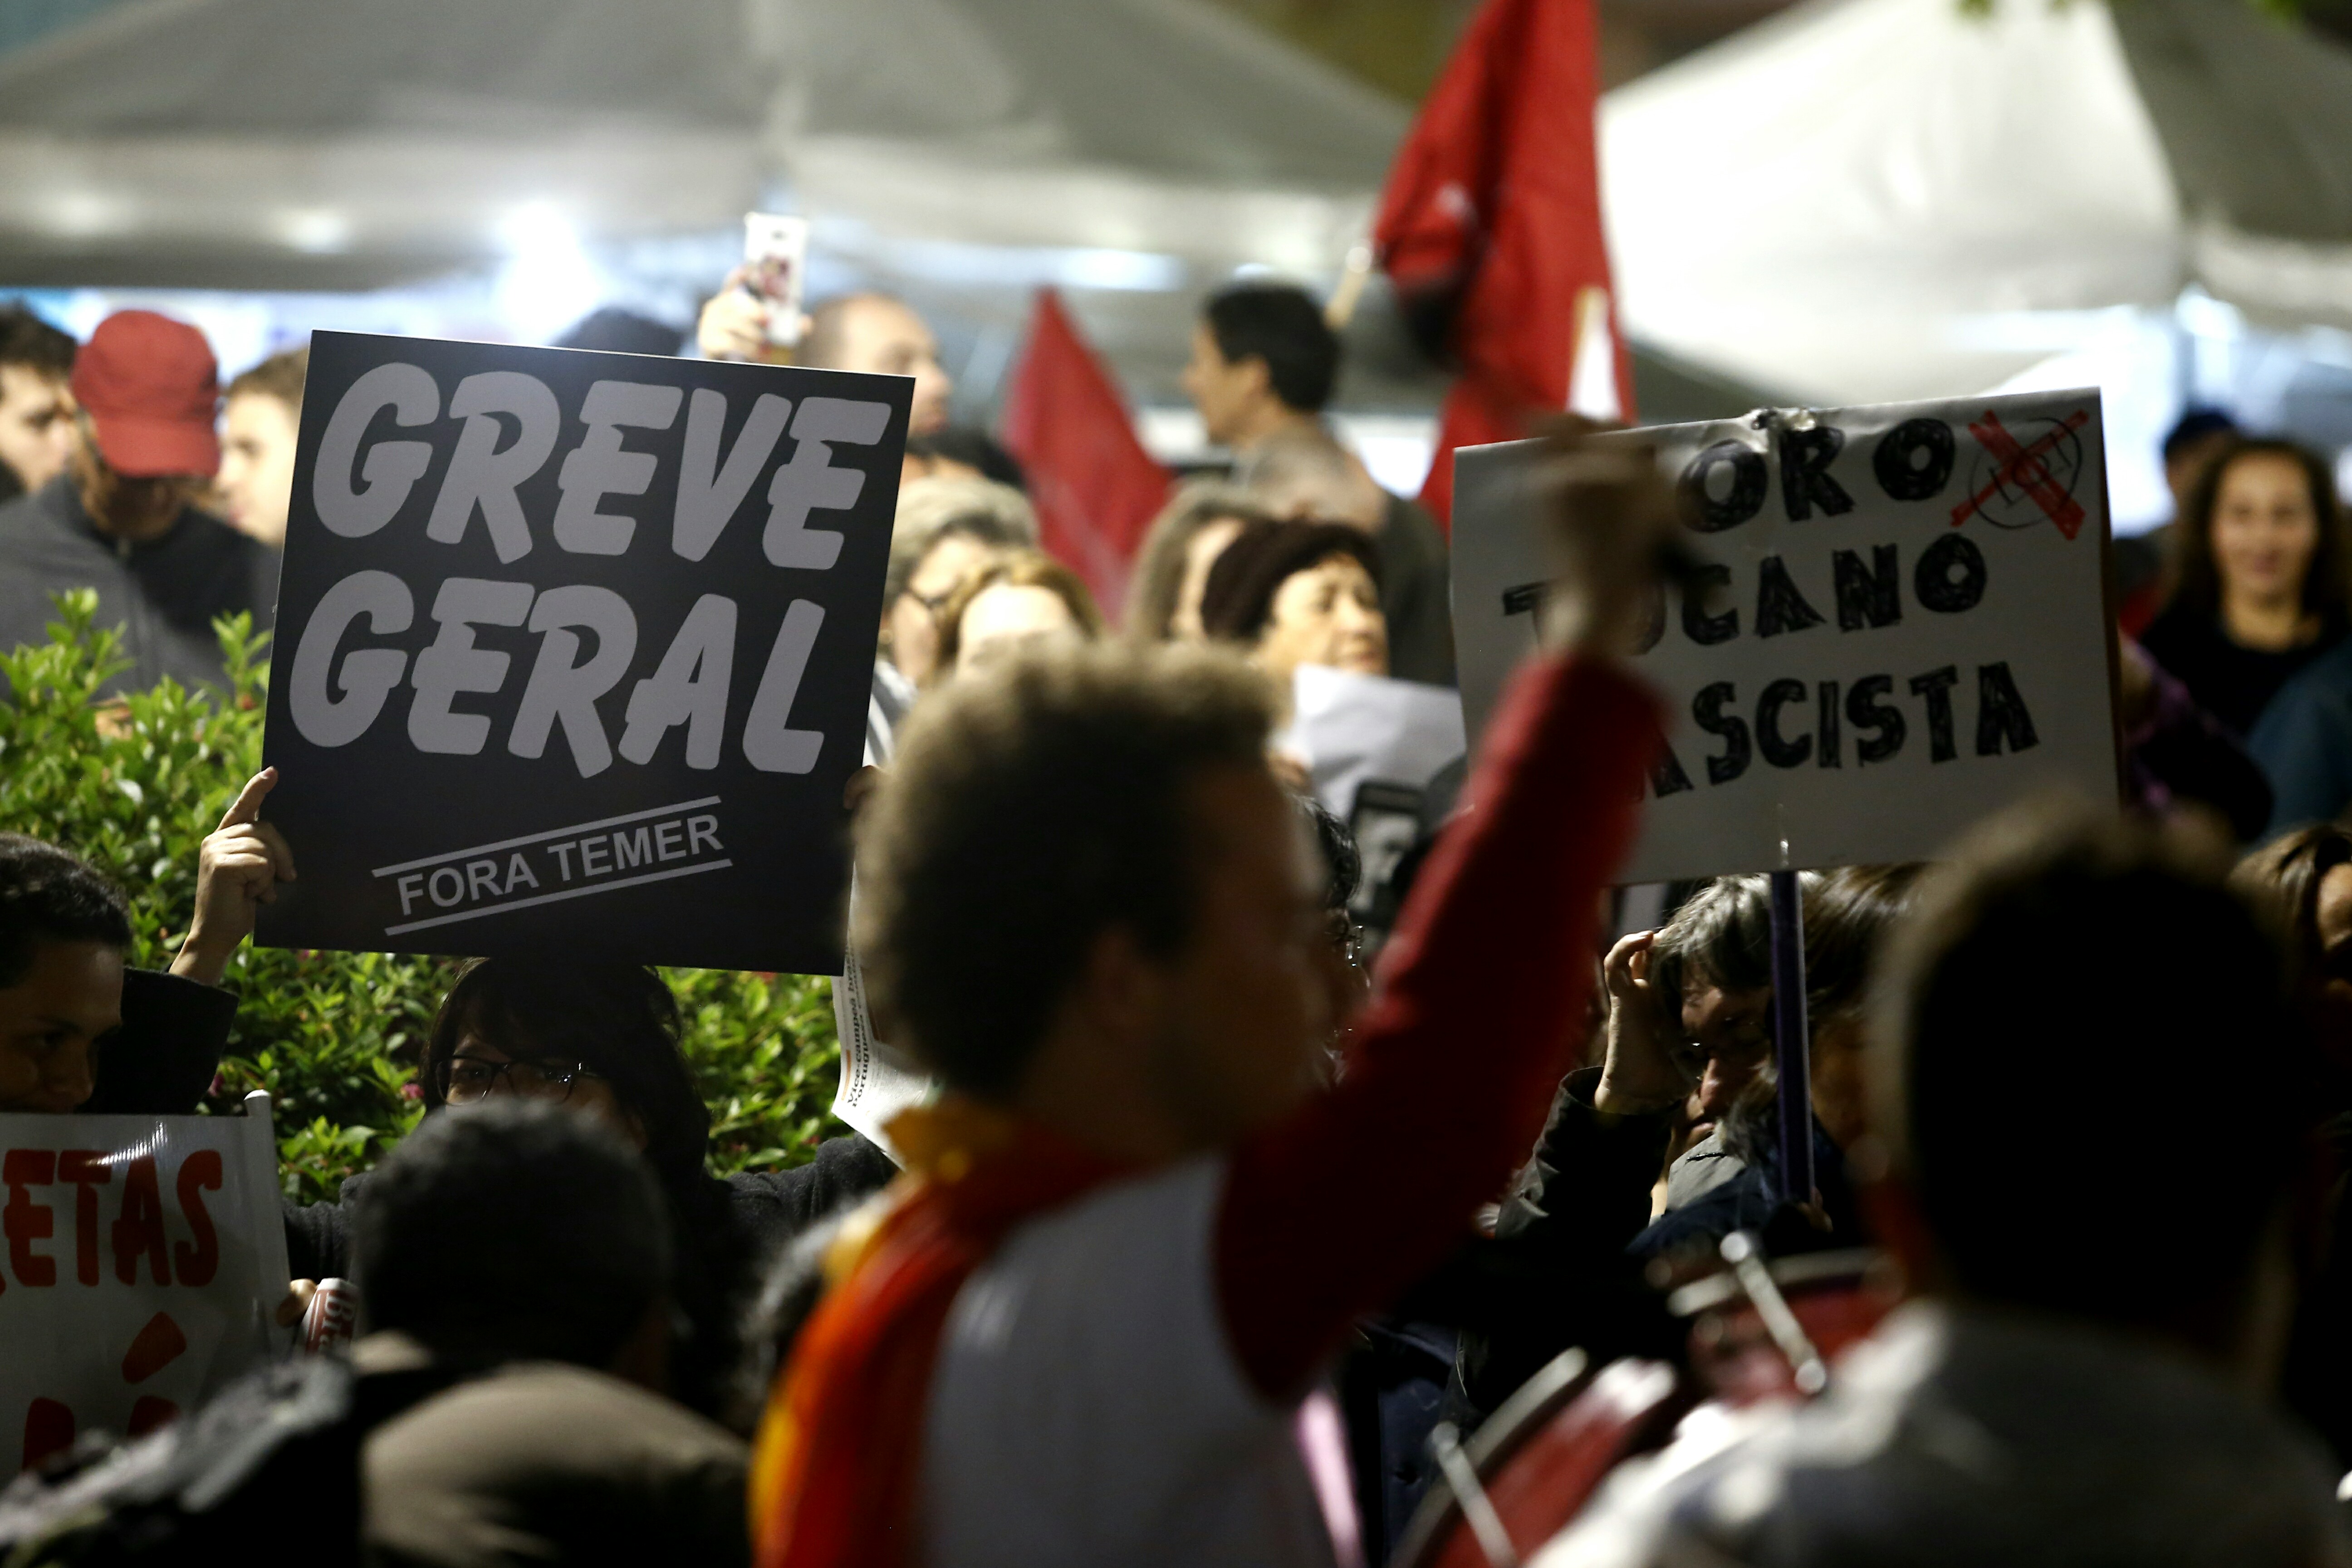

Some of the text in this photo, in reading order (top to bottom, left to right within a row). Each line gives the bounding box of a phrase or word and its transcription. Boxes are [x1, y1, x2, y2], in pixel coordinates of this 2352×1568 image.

[312, 362, 892, 570] GREVE
[1678, 418, 1956, 534] ORO
[289, 569, 826, 779] GERAL
[1629, 661, 2039, 798] ASCISTA
[397, 814, 724, 916] FORA TEMER
[0, 1149, 222, 1288] ETAS
